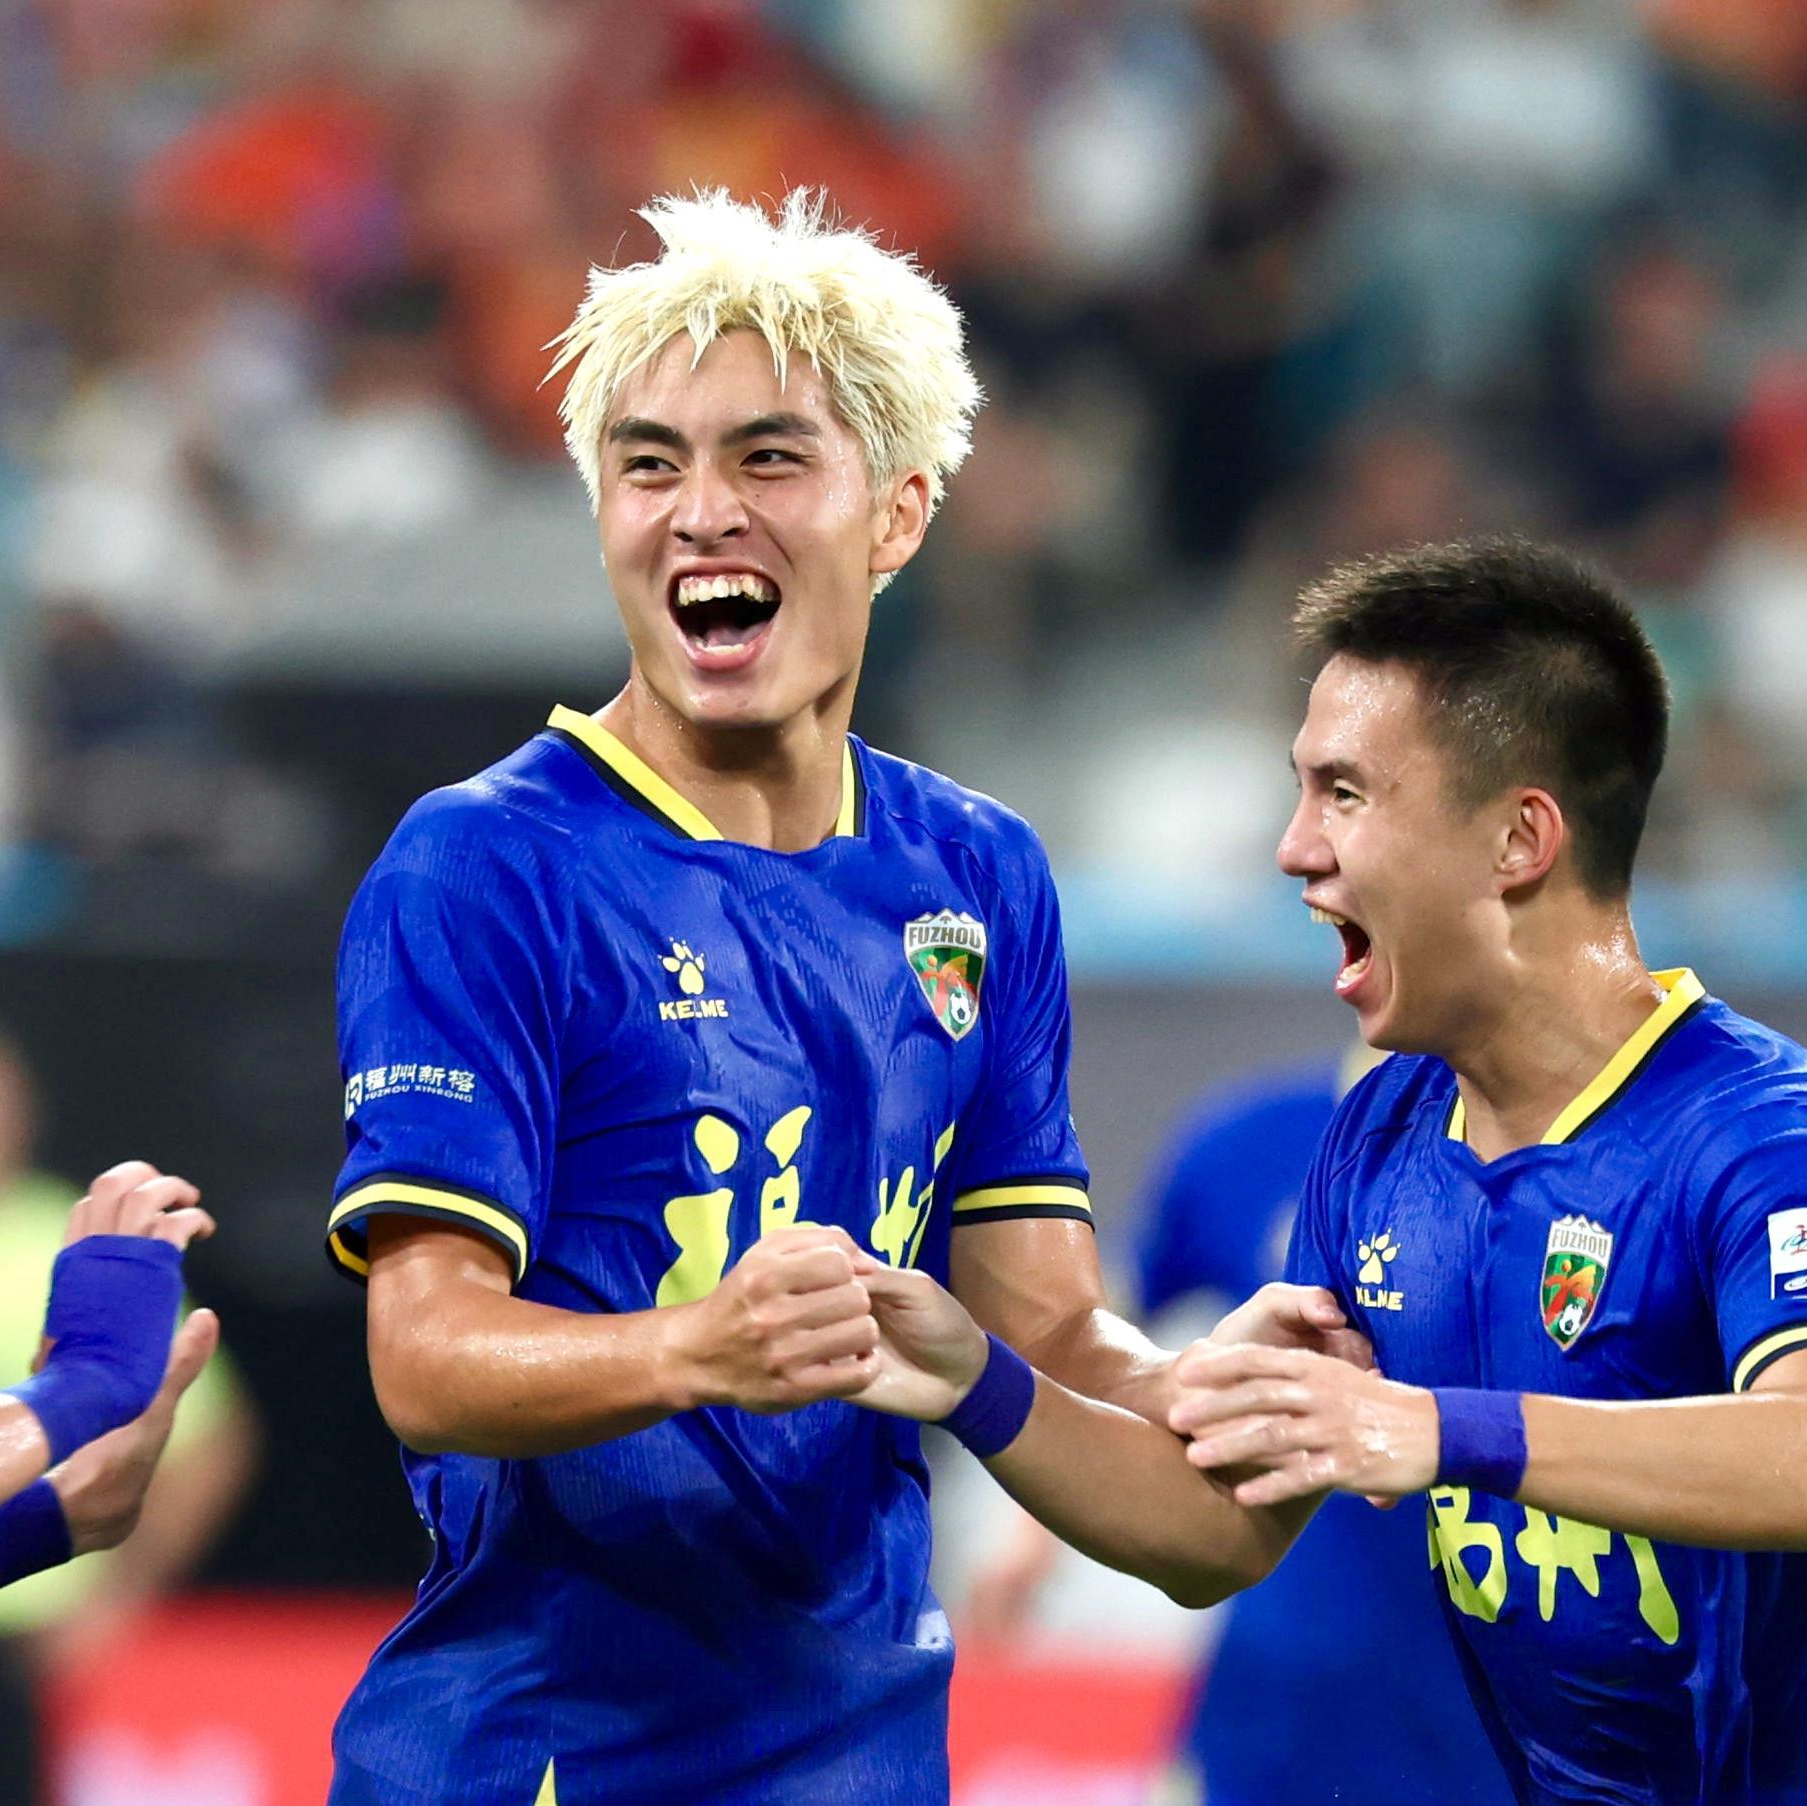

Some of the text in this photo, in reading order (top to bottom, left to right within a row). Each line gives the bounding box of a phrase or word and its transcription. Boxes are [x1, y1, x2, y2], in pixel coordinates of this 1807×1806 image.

[907, 925, 983, 950] FUZHOU
[365, 1062, 476, 1093] 福州新榕
[1550, 1226, 1609, 1259] FUZHOU
[1354, 1285, 1405, 1312] KLME
